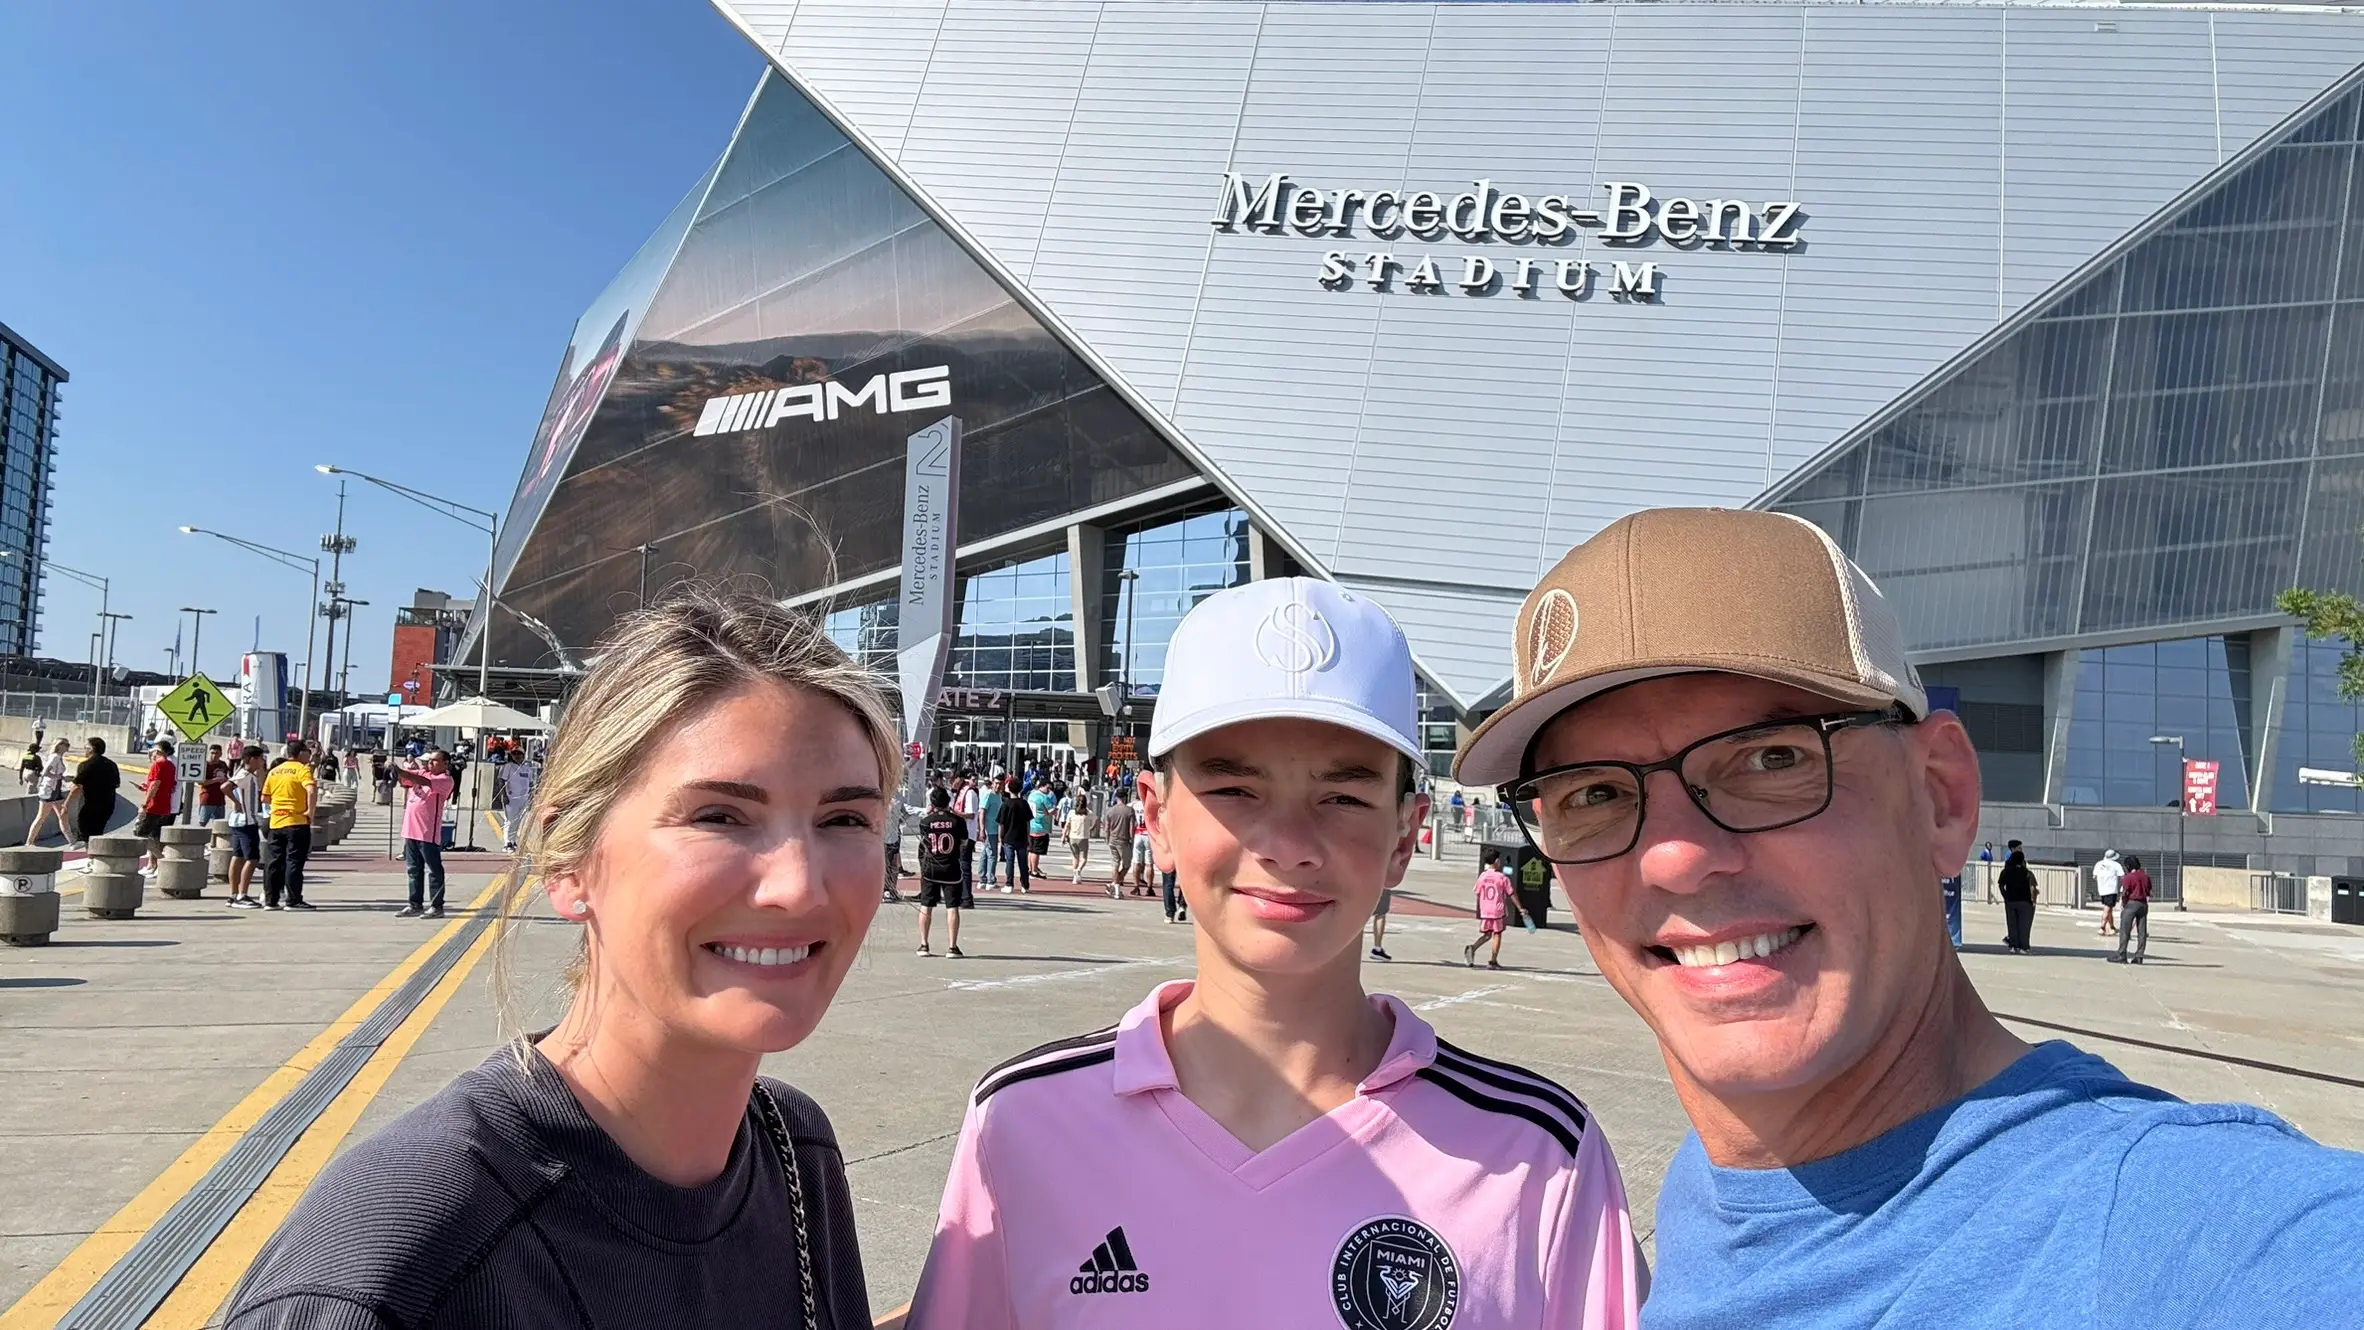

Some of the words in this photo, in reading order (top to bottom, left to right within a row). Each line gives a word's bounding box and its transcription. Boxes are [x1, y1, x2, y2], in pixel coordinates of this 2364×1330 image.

[1211, 171, 1801, 248] Mercedes-Benz
[1317, 249, 1659, 296] STADIUM
[764, 364, 952, 429] AMG
[909, 484, 930, 606] Mercedes-Benz
[929, 512, 941, 581] STADIUM
[938, 688, 980, 708] ATE
[987, 688, 1001, 709] 2
[1124, 736, 1137, 745] NOT
[181, 763, 202, 778] 15
[930, 821, 953, 829] MESSI
[928, 832, 955, 855] 10
[1481, 884, 1496, 901] 10
[1340, 1222, 1441, 1267] INTERNACIONAL
[1376, 1249, 1425, 1269] MIAMI
[1440, 1256, 1454, 1273] DE
[1069, 1270, 1150, 1295] adidas
[1337, 1273, 1352, 1311] CLUB
